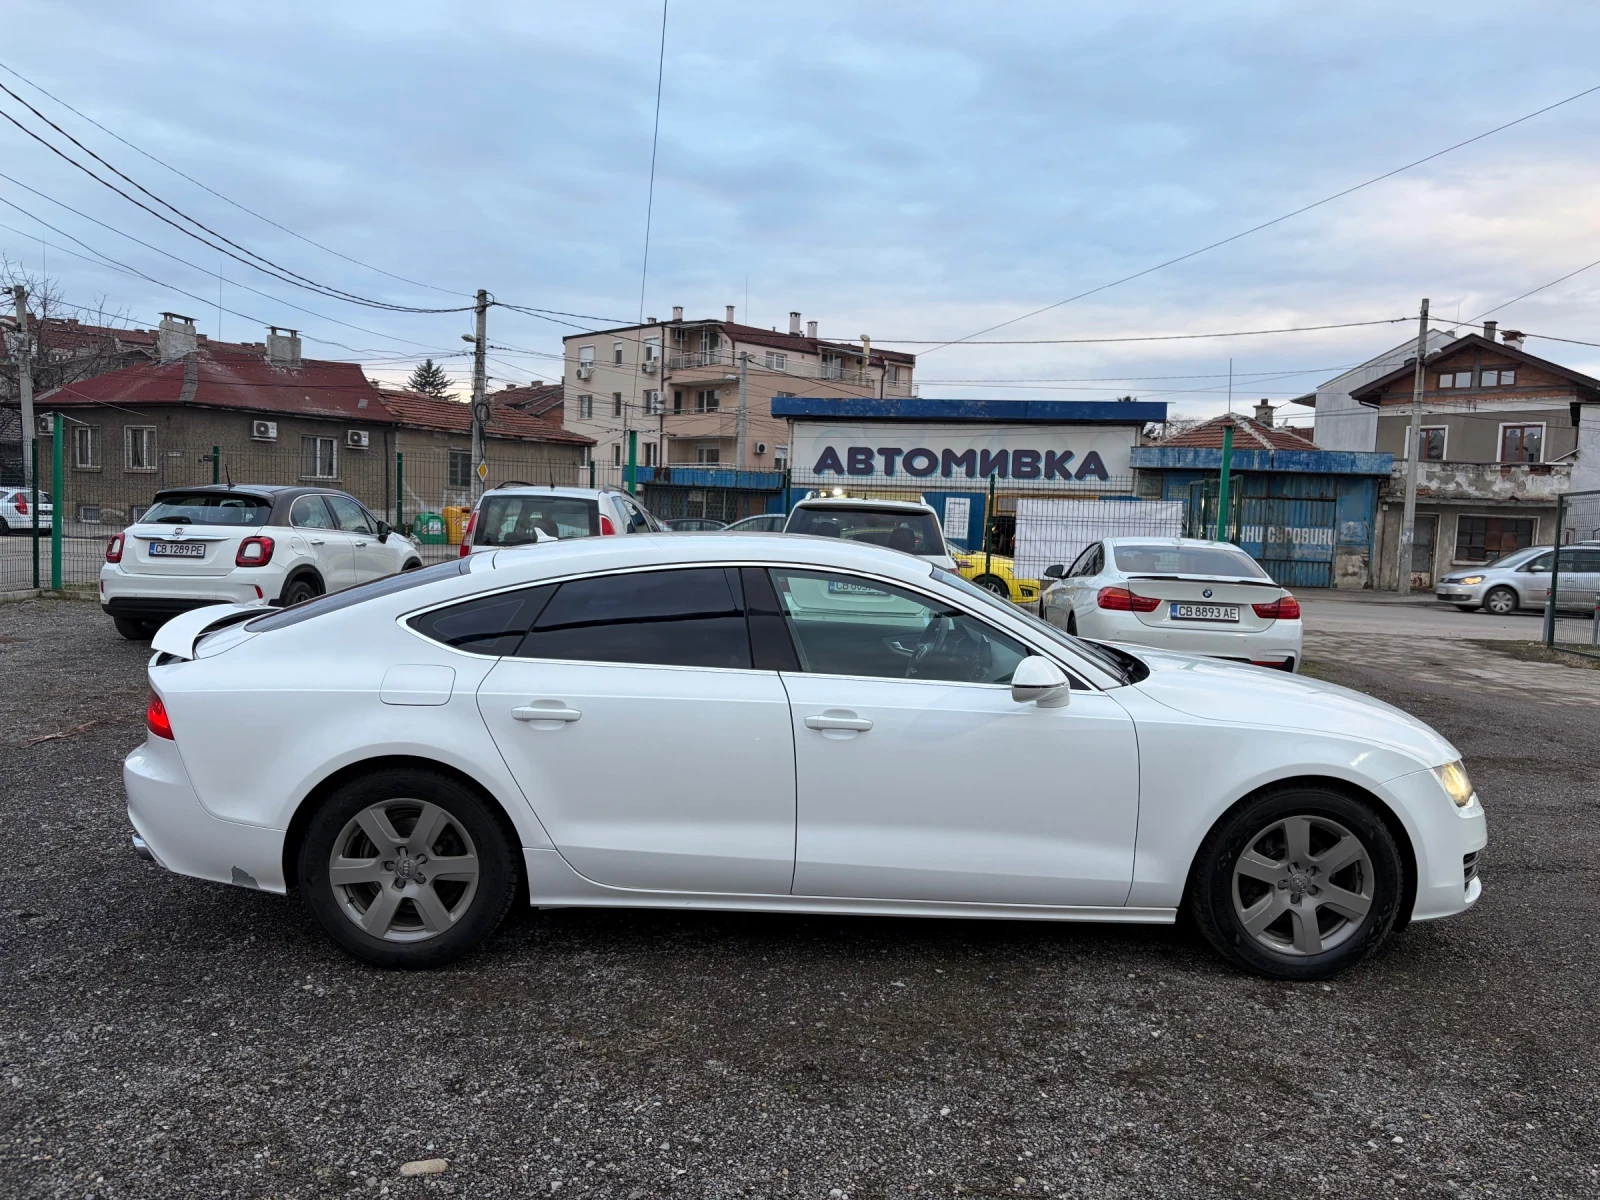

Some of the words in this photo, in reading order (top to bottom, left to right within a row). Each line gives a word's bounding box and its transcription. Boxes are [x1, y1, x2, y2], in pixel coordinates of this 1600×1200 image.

[813, 446, 1109, 481] АВТОМИВКА
[156, 544, 167, 554] CB
[170, 545, 190, 554] 1289
[191, 546, 202, 554] PE
[1179, 606, 1193, 616] CB
[1195, 607, 1221, 618] 8893
[1223, 608, 1237, 619] AE
